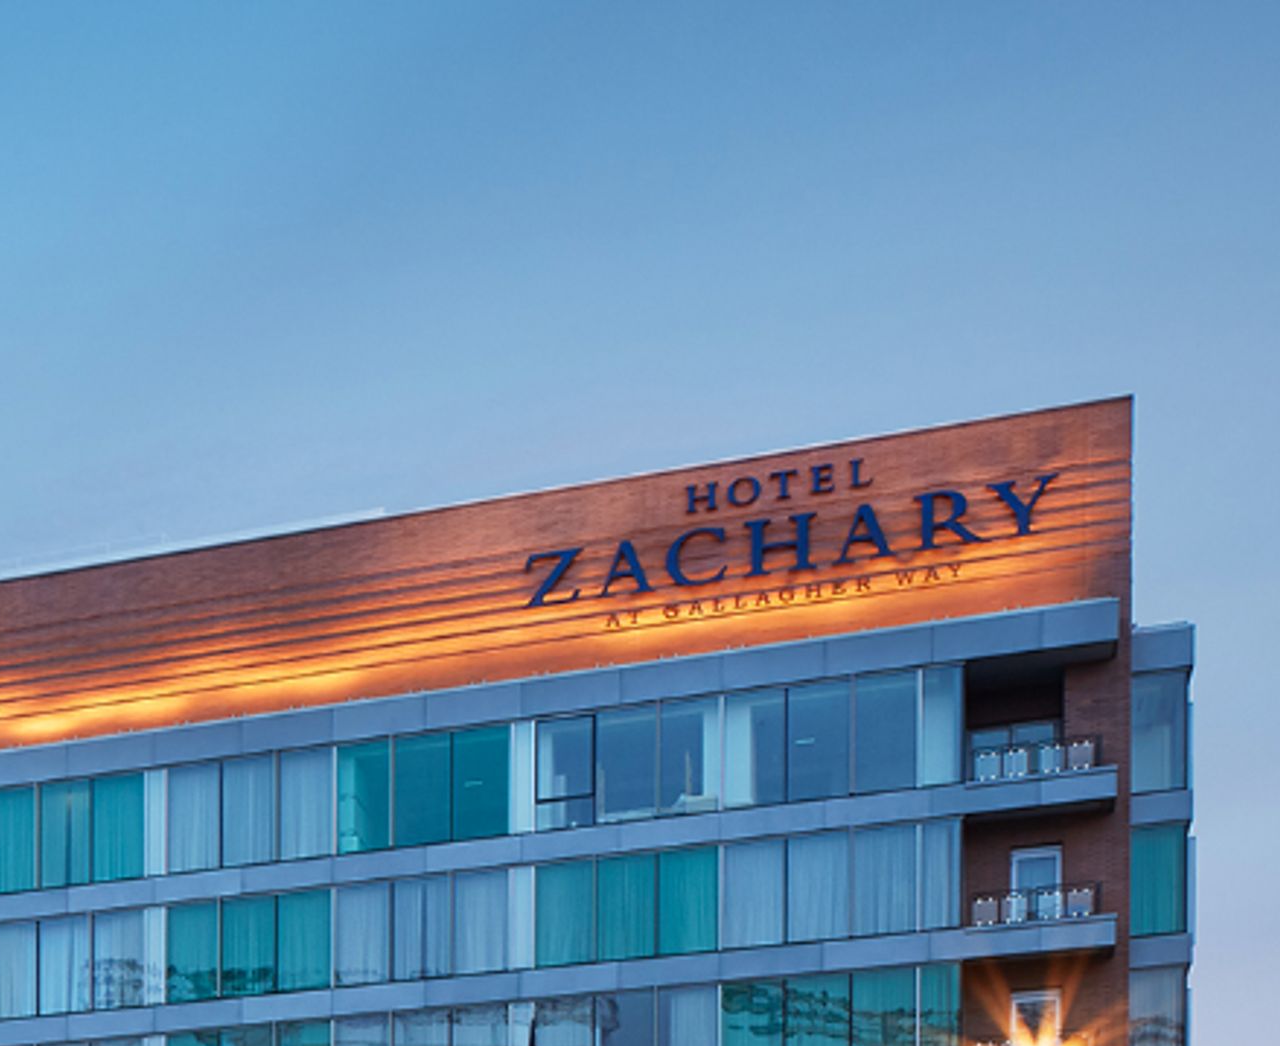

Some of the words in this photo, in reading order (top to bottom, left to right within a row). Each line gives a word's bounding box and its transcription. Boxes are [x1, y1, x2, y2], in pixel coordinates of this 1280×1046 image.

[685, 458, 874, 514] HOTEL
[524, 472, 1059, 609] ZACHARY
[605, 611, 638, 628] AT
[662, 576, 872, 620] GALLAGHER
[894, 563, 963, 587] WAY
